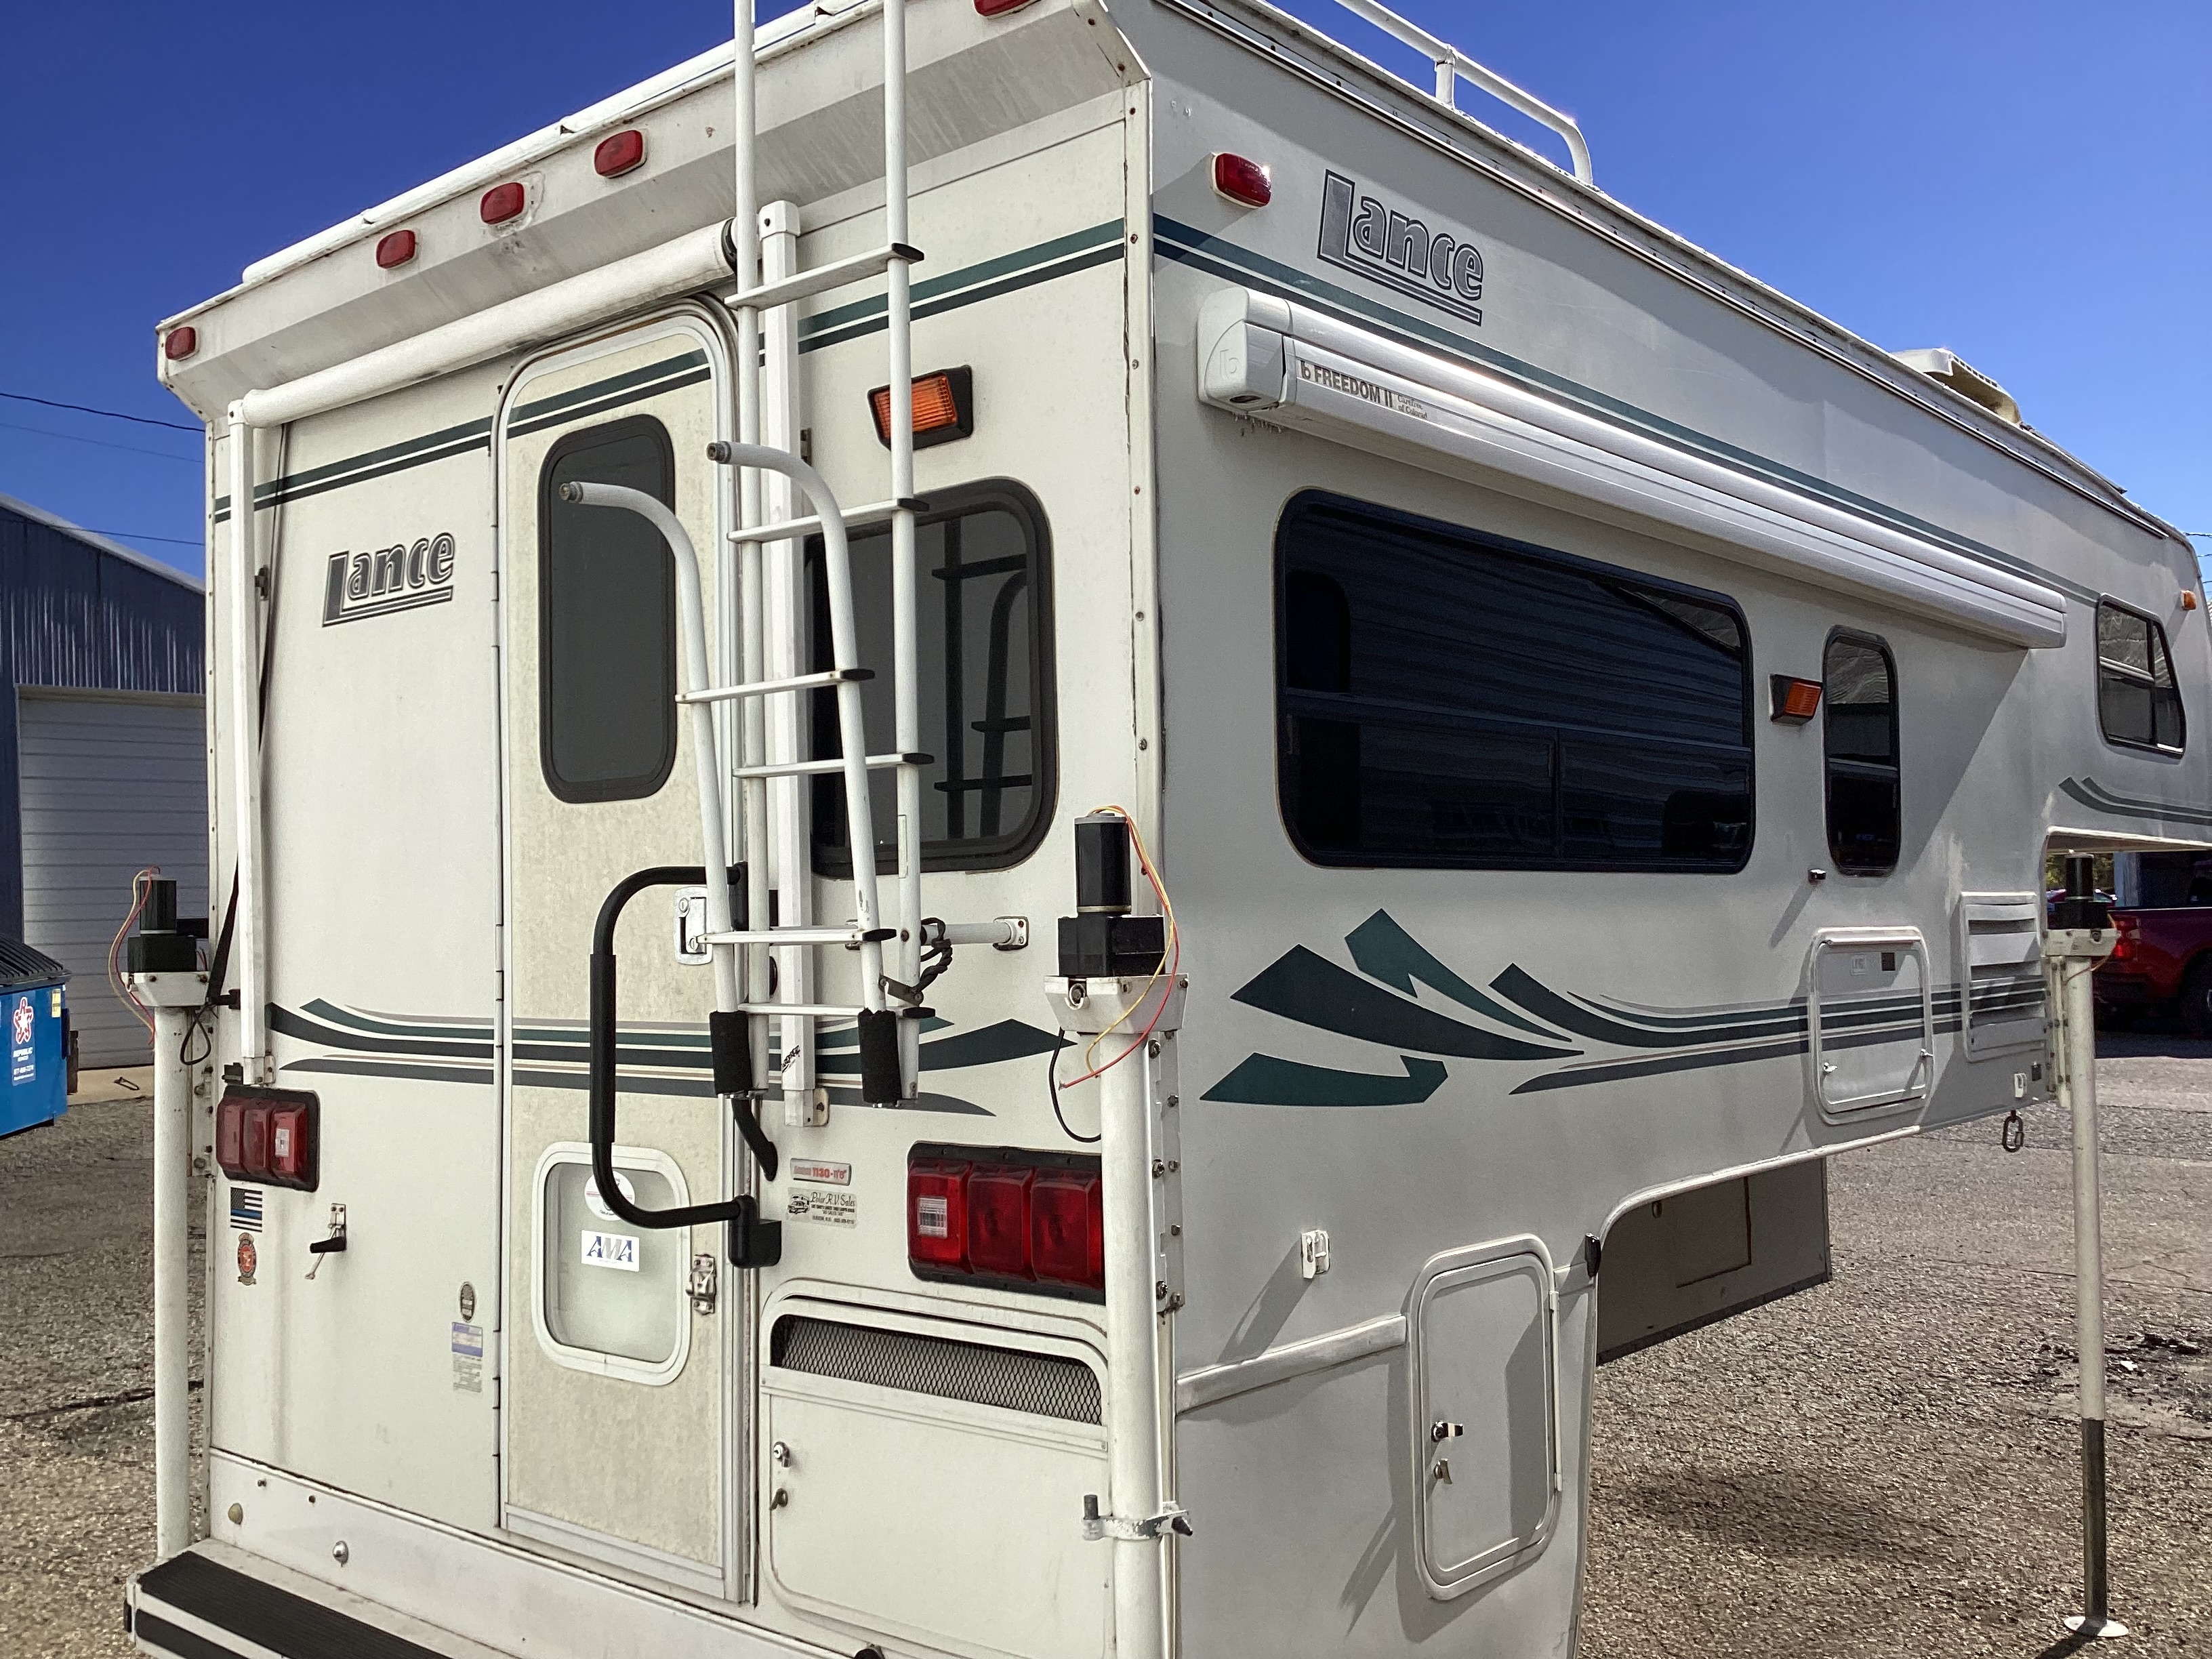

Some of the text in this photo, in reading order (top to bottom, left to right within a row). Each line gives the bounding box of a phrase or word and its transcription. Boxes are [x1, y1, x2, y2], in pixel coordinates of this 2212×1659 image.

[1317, 169, 1483, 327] Lance
[1313, 365, 1380, 404] FREEDOM
[1384, 389, 1393, 408] II
[322, 532, 455, 628] Lance
[840, 1194, 855, 1206] Sales
